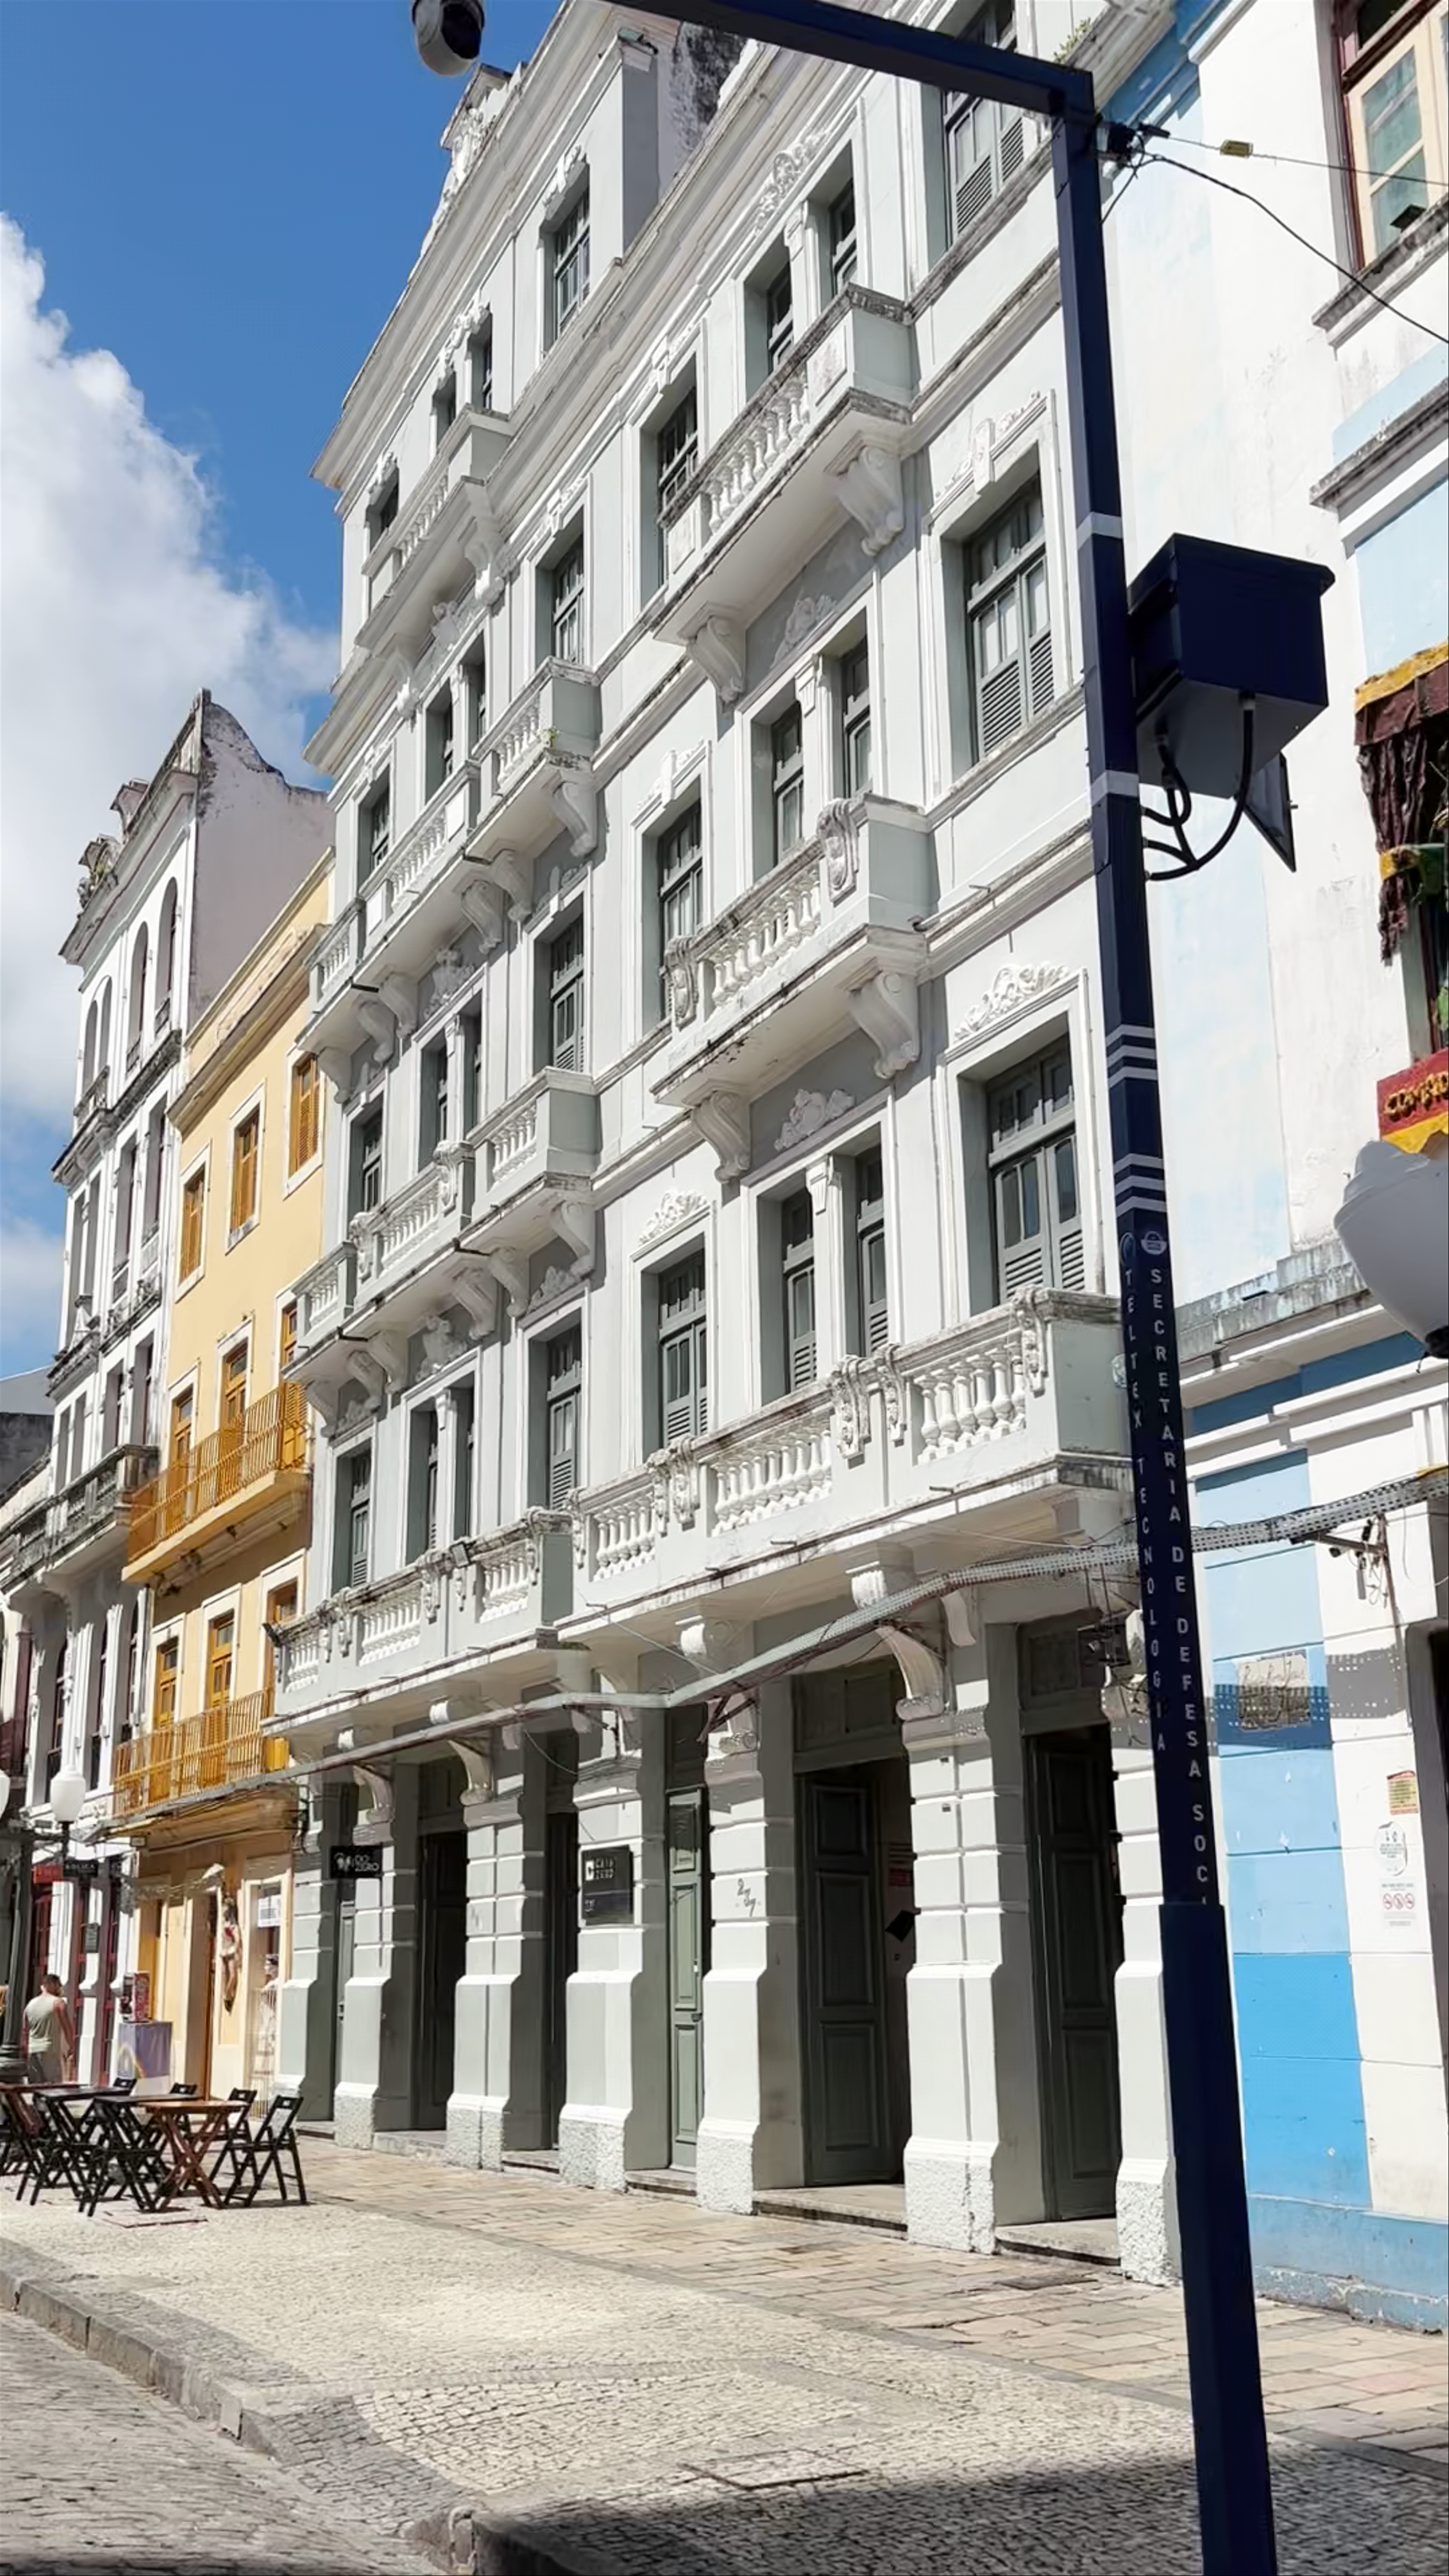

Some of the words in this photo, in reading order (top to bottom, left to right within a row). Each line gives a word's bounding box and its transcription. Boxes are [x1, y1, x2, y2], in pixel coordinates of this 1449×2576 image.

[1151, 1268, 1181, 1521] SECRETARIA
[1125, 1269, 1142, 1428] TELTEX
[1137, 1457, 1165, 1750] TECNOLOGIA
[1172, 1546, 1186, 1593] DE
[1177, 1618, 1201, 1777] DEFESA
[1193, 1804, 1208, 1905] SOC
